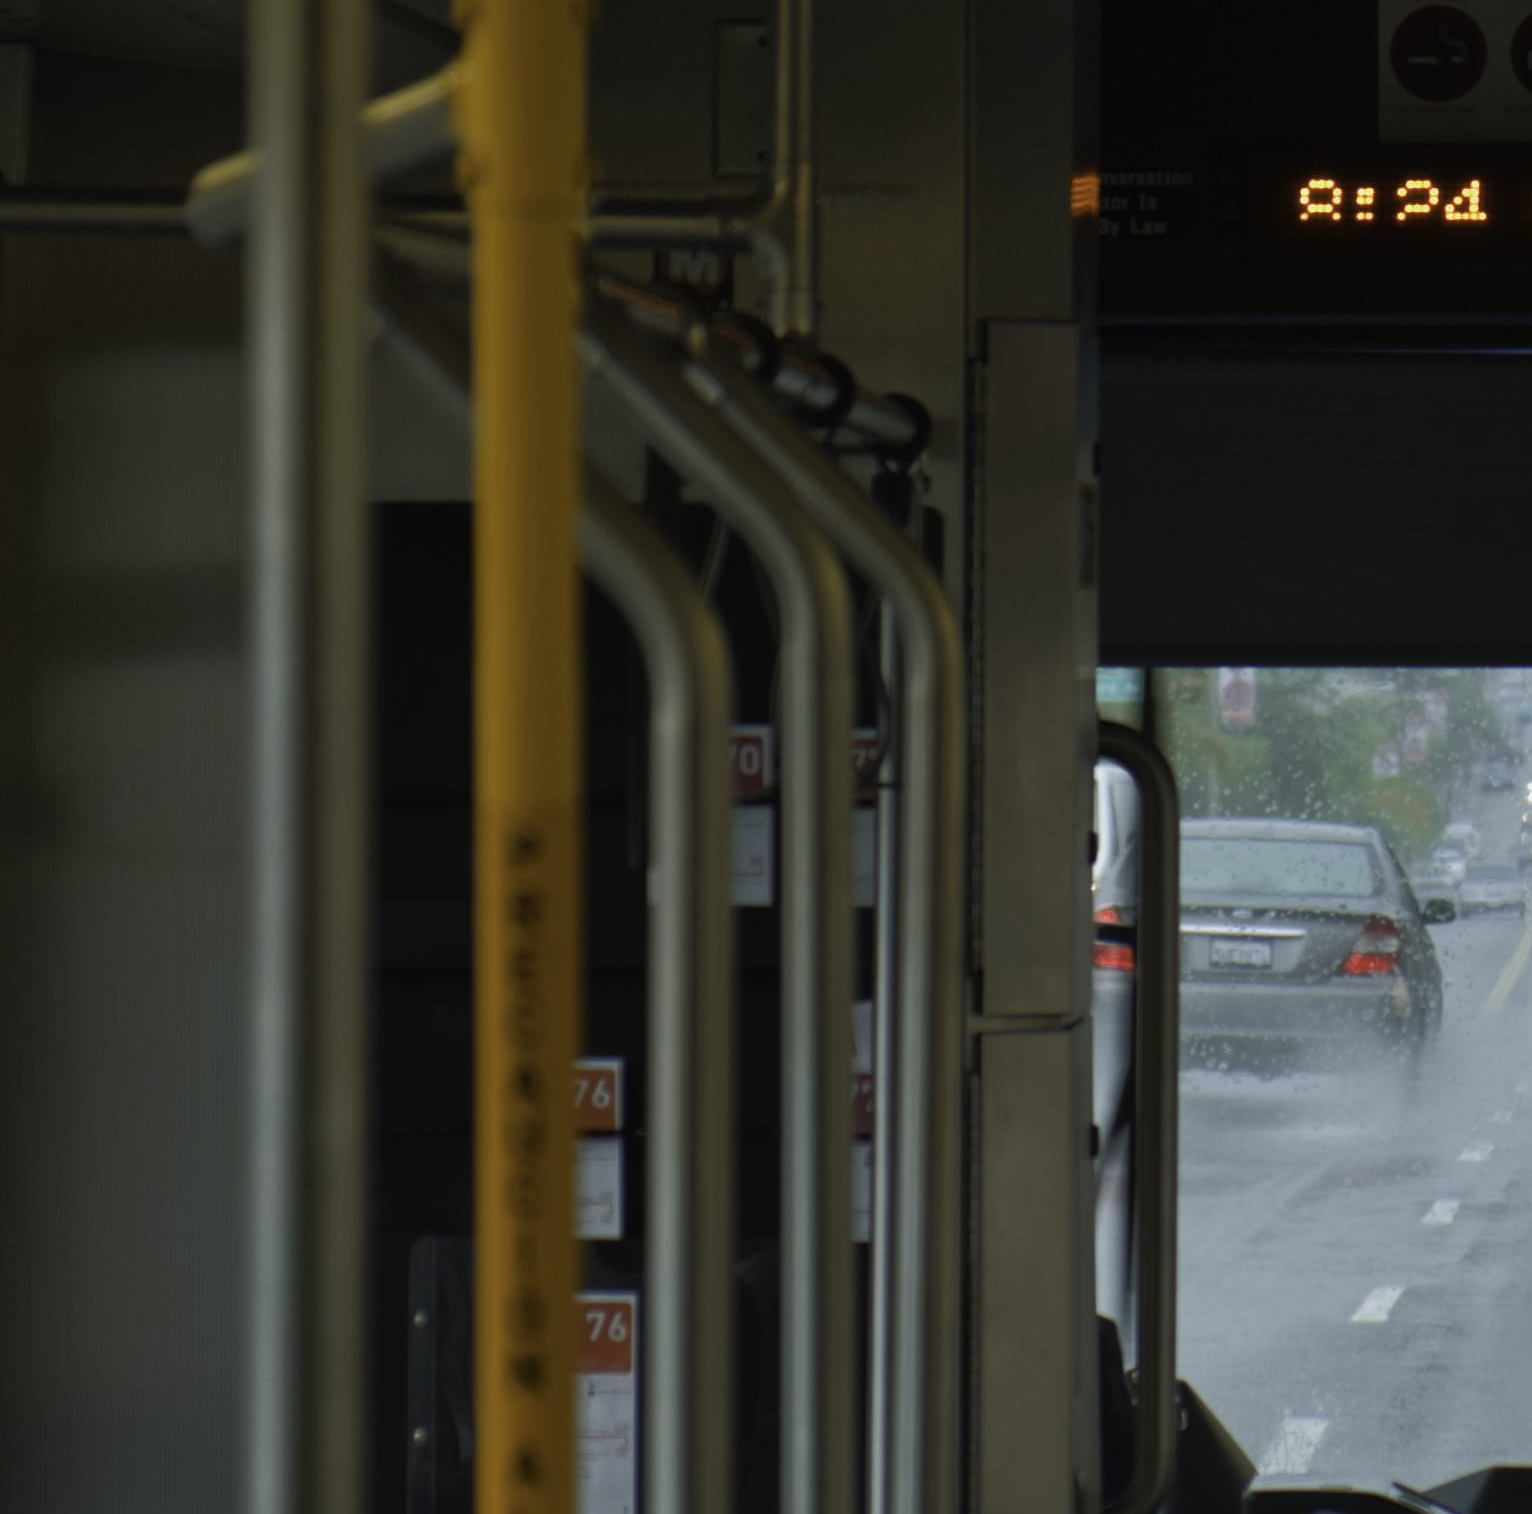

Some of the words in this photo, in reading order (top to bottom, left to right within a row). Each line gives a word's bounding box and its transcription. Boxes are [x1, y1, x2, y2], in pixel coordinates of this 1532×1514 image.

[1130, 217, 1168, 235] Law
[574, 1078, 611, 1110] 76
[585, 1309, 627, 1343] 76
